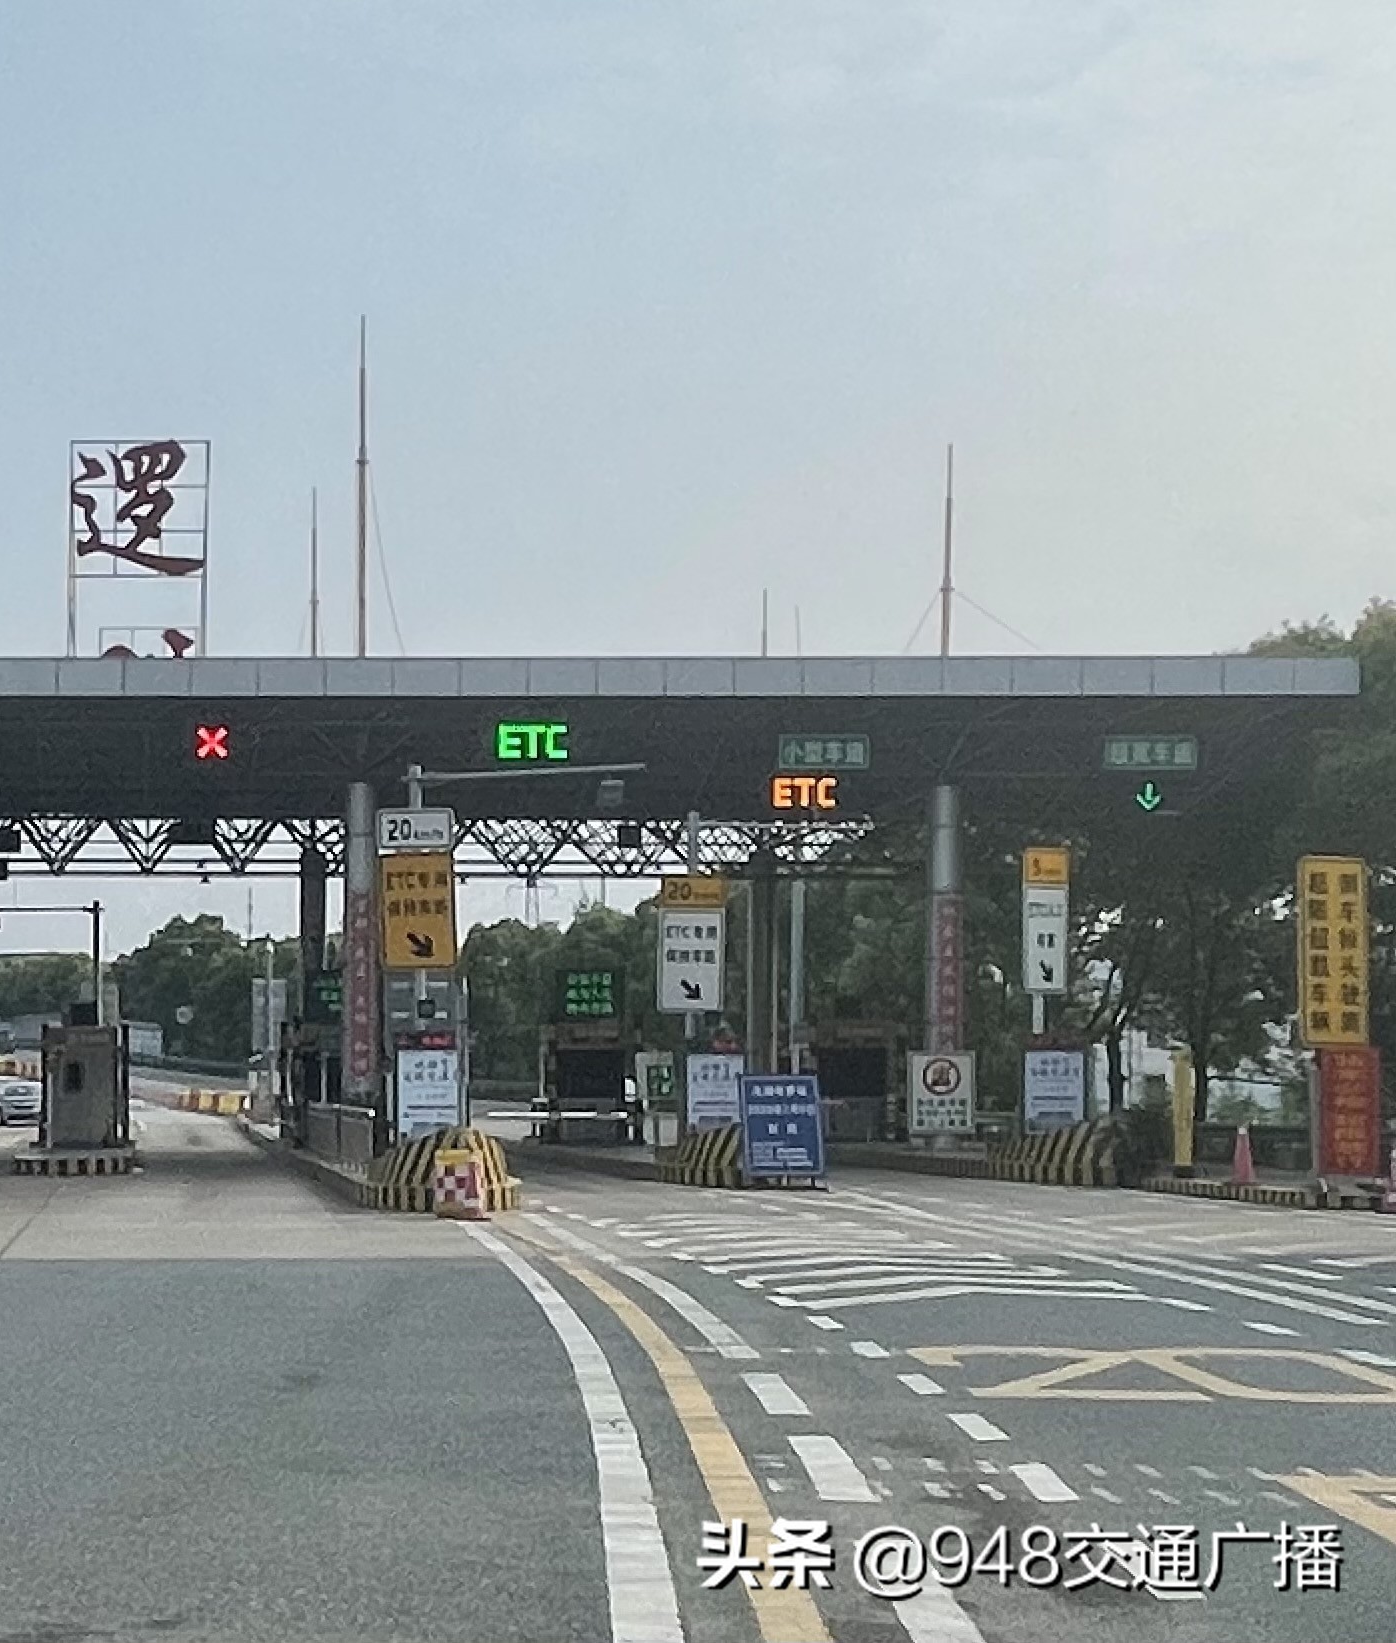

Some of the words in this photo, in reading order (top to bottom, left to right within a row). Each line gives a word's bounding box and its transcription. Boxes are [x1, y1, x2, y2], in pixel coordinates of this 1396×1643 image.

[498, 723, 568, 759] ETC
[772, 777, 837, 808] ETC
[666, 881, 692, 901] 20
